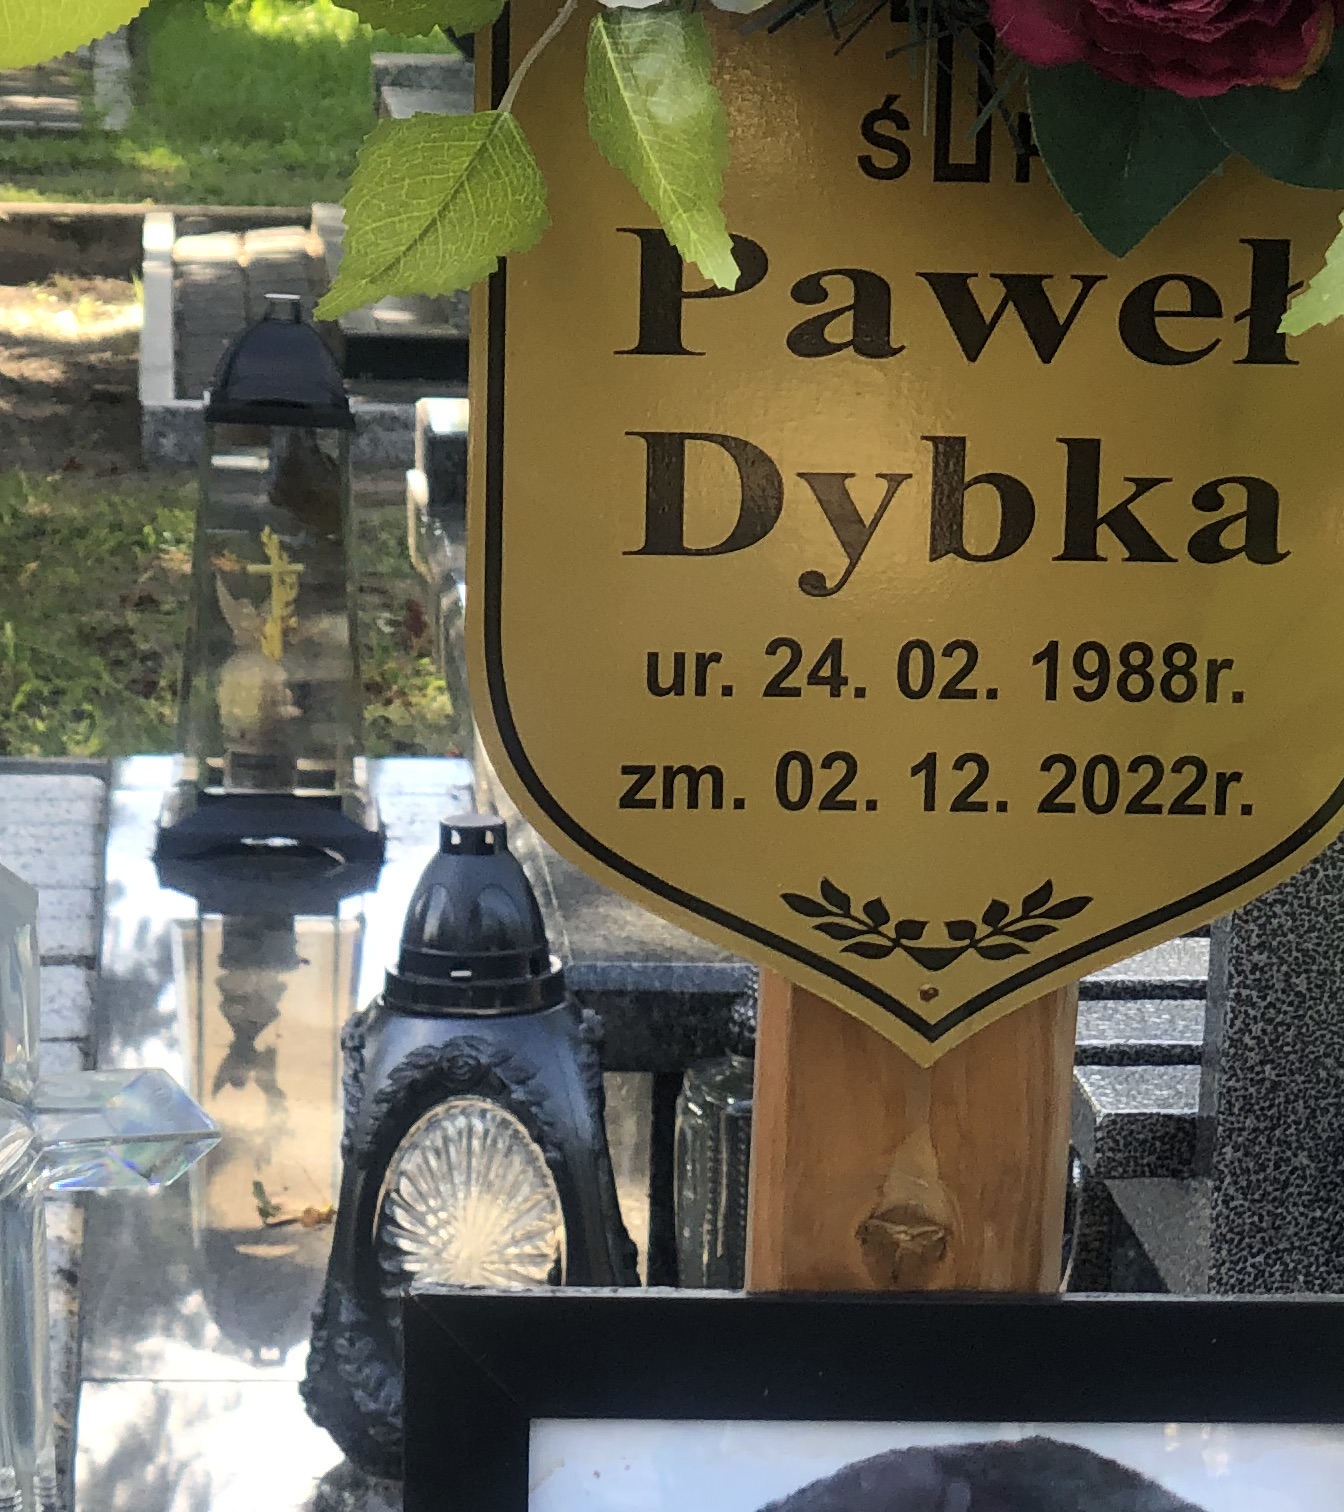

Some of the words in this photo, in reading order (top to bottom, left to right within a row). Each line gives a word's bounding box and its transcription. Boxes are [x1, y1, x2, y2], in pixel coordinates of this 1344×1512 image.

[613, 226, 1306, 366] Paweł
[622, 430, 1292, 598] Dybka
[646, 650, 734, 698] ur.
[762, 637, 867, 700] 24.
[896, 638, 999, 701] 02.
[1032, 640, 1245, 705] 1988r.
[618, 764, 746, 811] zm.
[775, 750, 878, 813] 02.
[910, 751, 1009, 814] 12.
[1036, 752, 1254, 817] 2022r.
